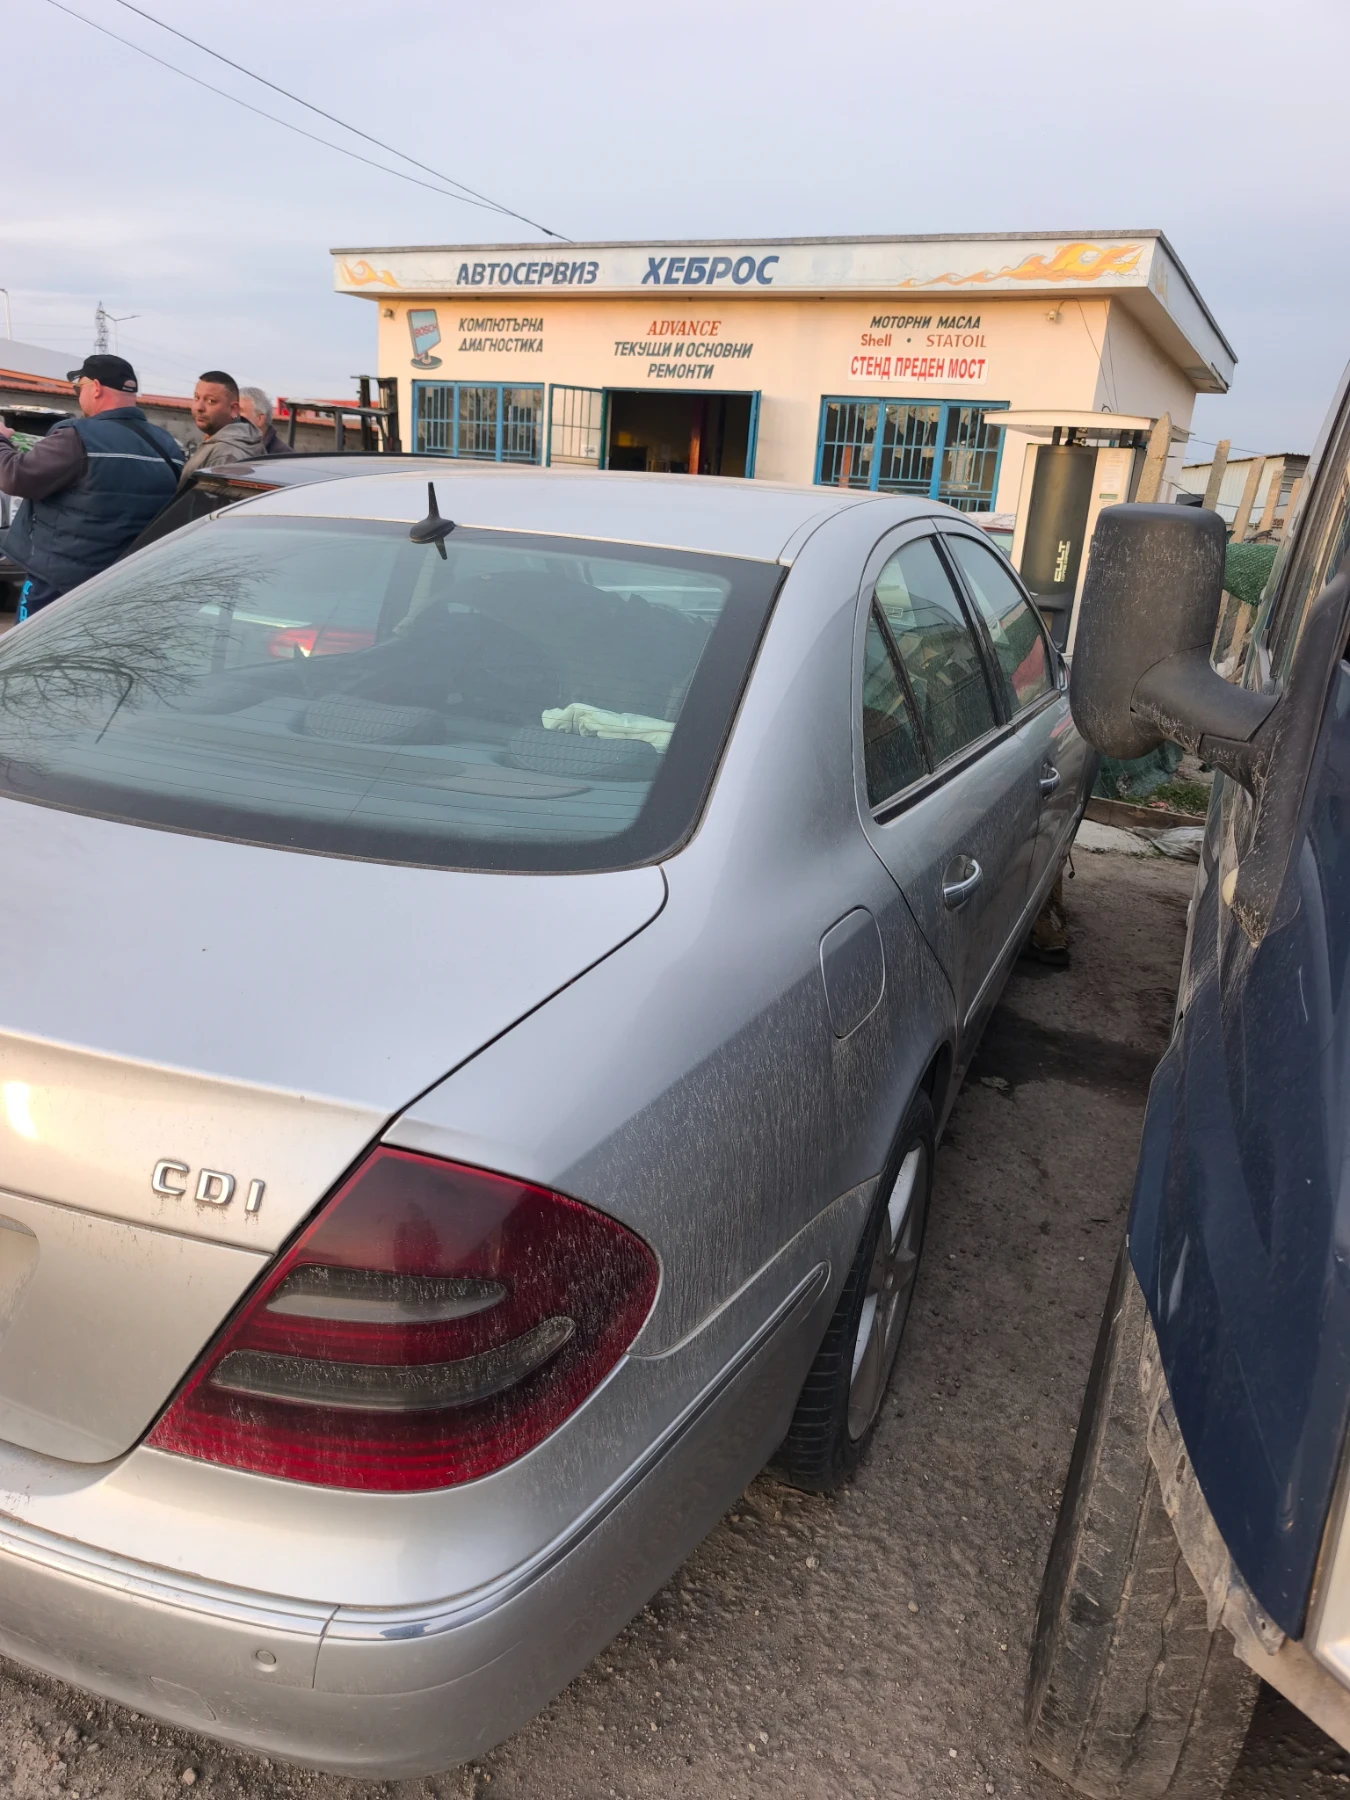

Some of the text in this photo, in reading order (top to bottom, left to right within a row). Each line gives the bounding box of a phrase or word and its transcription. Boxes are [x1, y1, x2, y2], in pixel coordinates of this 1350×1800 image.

[456, 255, 780, 286] АВТОСЕРВИЗ ХЕБРОС
[458, 317, 544, 333] КОМПЮТЪРНА
[646, 320, 722, 337] ADVANCE
[869, 315, 982, 330] МОТОРНИ МАСЛА
[458, 337, 544, 353] ДИАГНОСТИКА
[860, 333, 987, 348] Shell STATOIL
[613, 341, 754, 359] ТЕКУЩИ И ОСНОВНИ
[647, 363, 715, 380] РЕМОНТИ
[850, 355, 986, 382] СТЕНД ПРЕДЕН МОСТ
[1053, 540, 1067, 582] CULT
[152, 1159, 266, 1213] CDI
